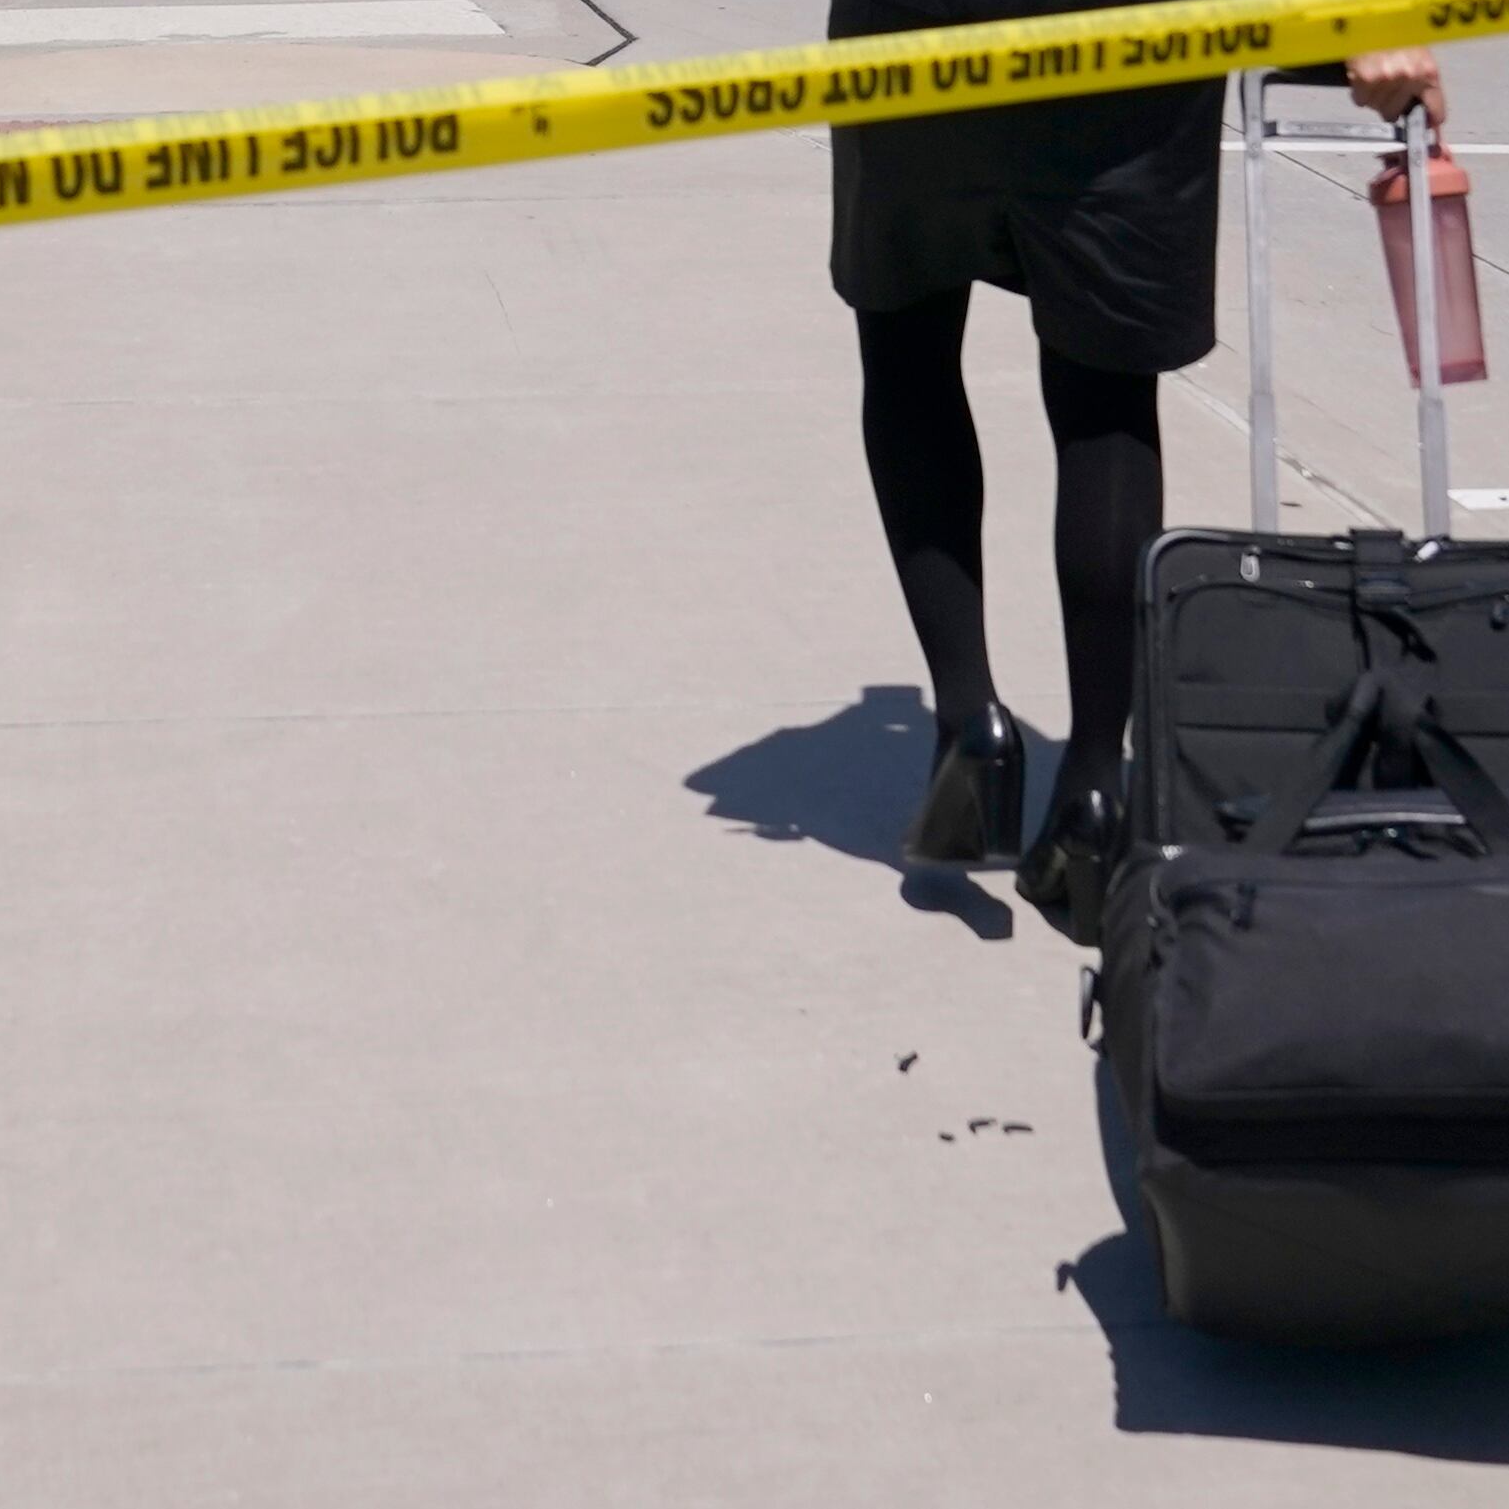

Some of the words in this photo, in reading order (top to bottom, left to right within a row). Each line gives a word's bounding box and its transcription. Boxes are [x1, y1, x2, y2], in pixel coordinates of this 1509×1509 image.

[646, 75, 807, 130] CROSS
[822, 63, 914, 105] NOT
[145, 133, 262, 191] LINE
[281, 112, 460, 176] POLICE
[53, 149, 126, 204] DO
